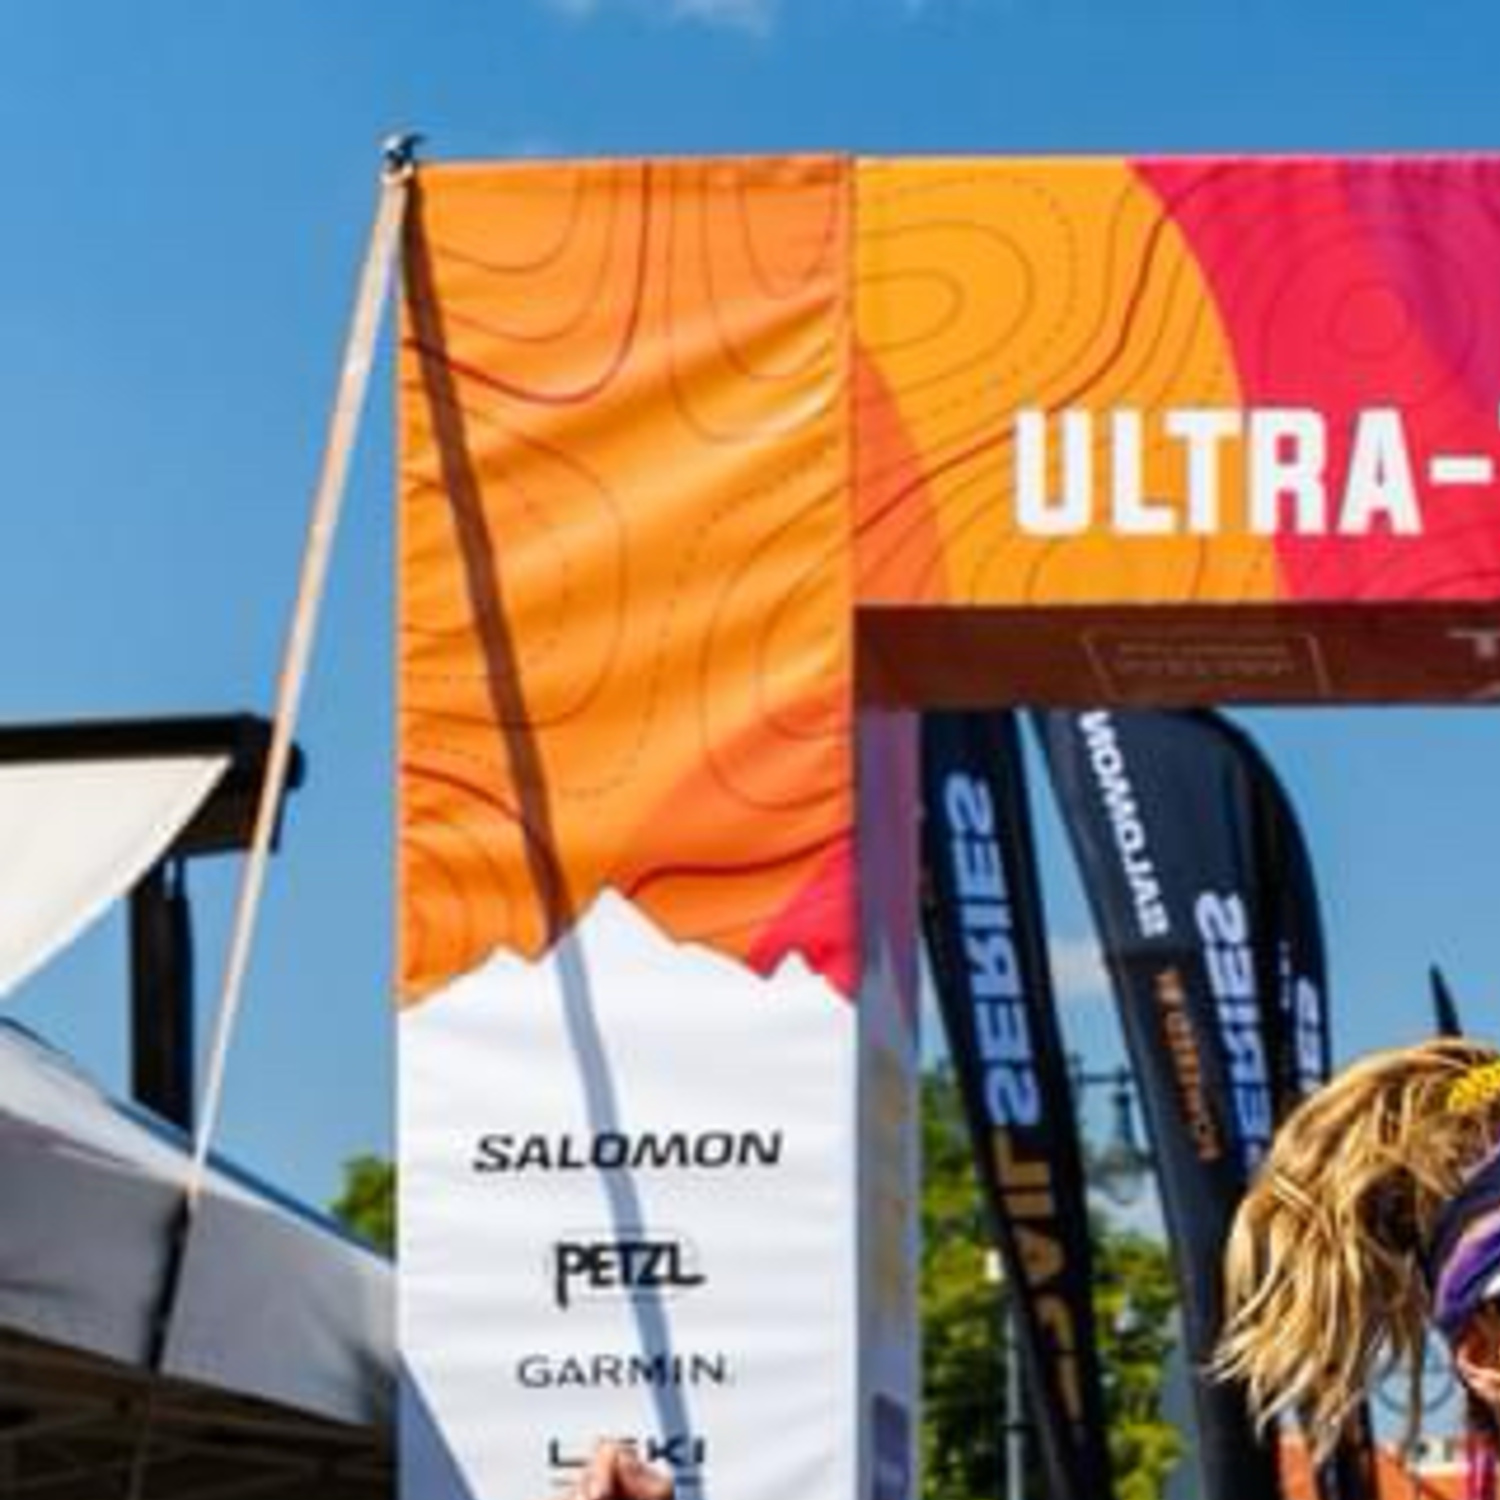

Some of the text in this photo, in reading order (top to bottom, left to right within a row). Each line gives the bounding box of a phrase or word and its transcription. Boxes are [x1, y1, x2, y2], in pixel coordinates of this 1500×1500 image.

[471, 1129, 783, 1173] SALOMON
[554, 1242, 706, 1310] PETZL
[516, 1352, 729, 1388] GARMIN
[548, 1436, 706, 1468] LKI
